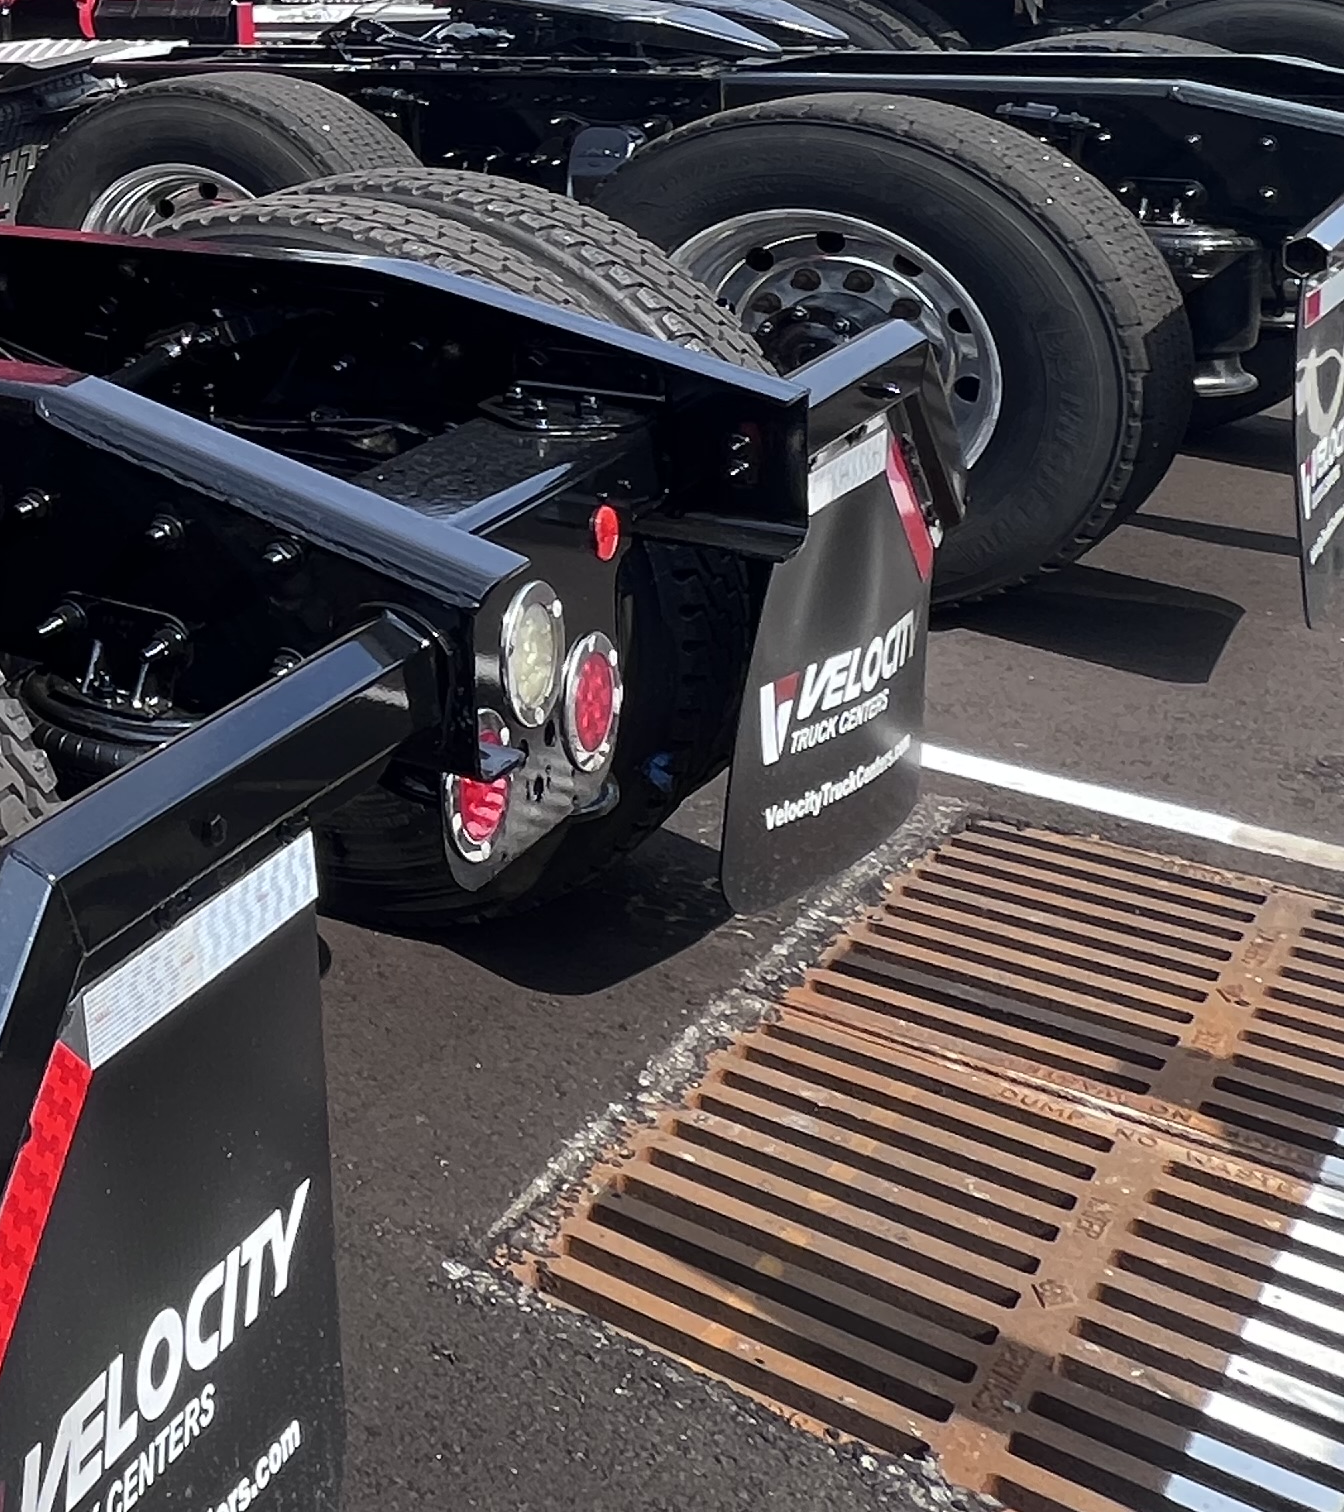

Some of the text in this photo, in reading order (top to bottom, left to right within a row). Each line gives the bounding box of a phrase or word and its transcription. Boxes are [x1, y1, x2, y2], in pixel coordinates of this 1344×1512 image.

[790, 688, 890, 754] TRUCK CENTERS
[1115, 1127, 1158, 1148] NO
[20, 1177, 311, 1512] VELOCITY
[106, 1383, 216, 1512] CENTERS
